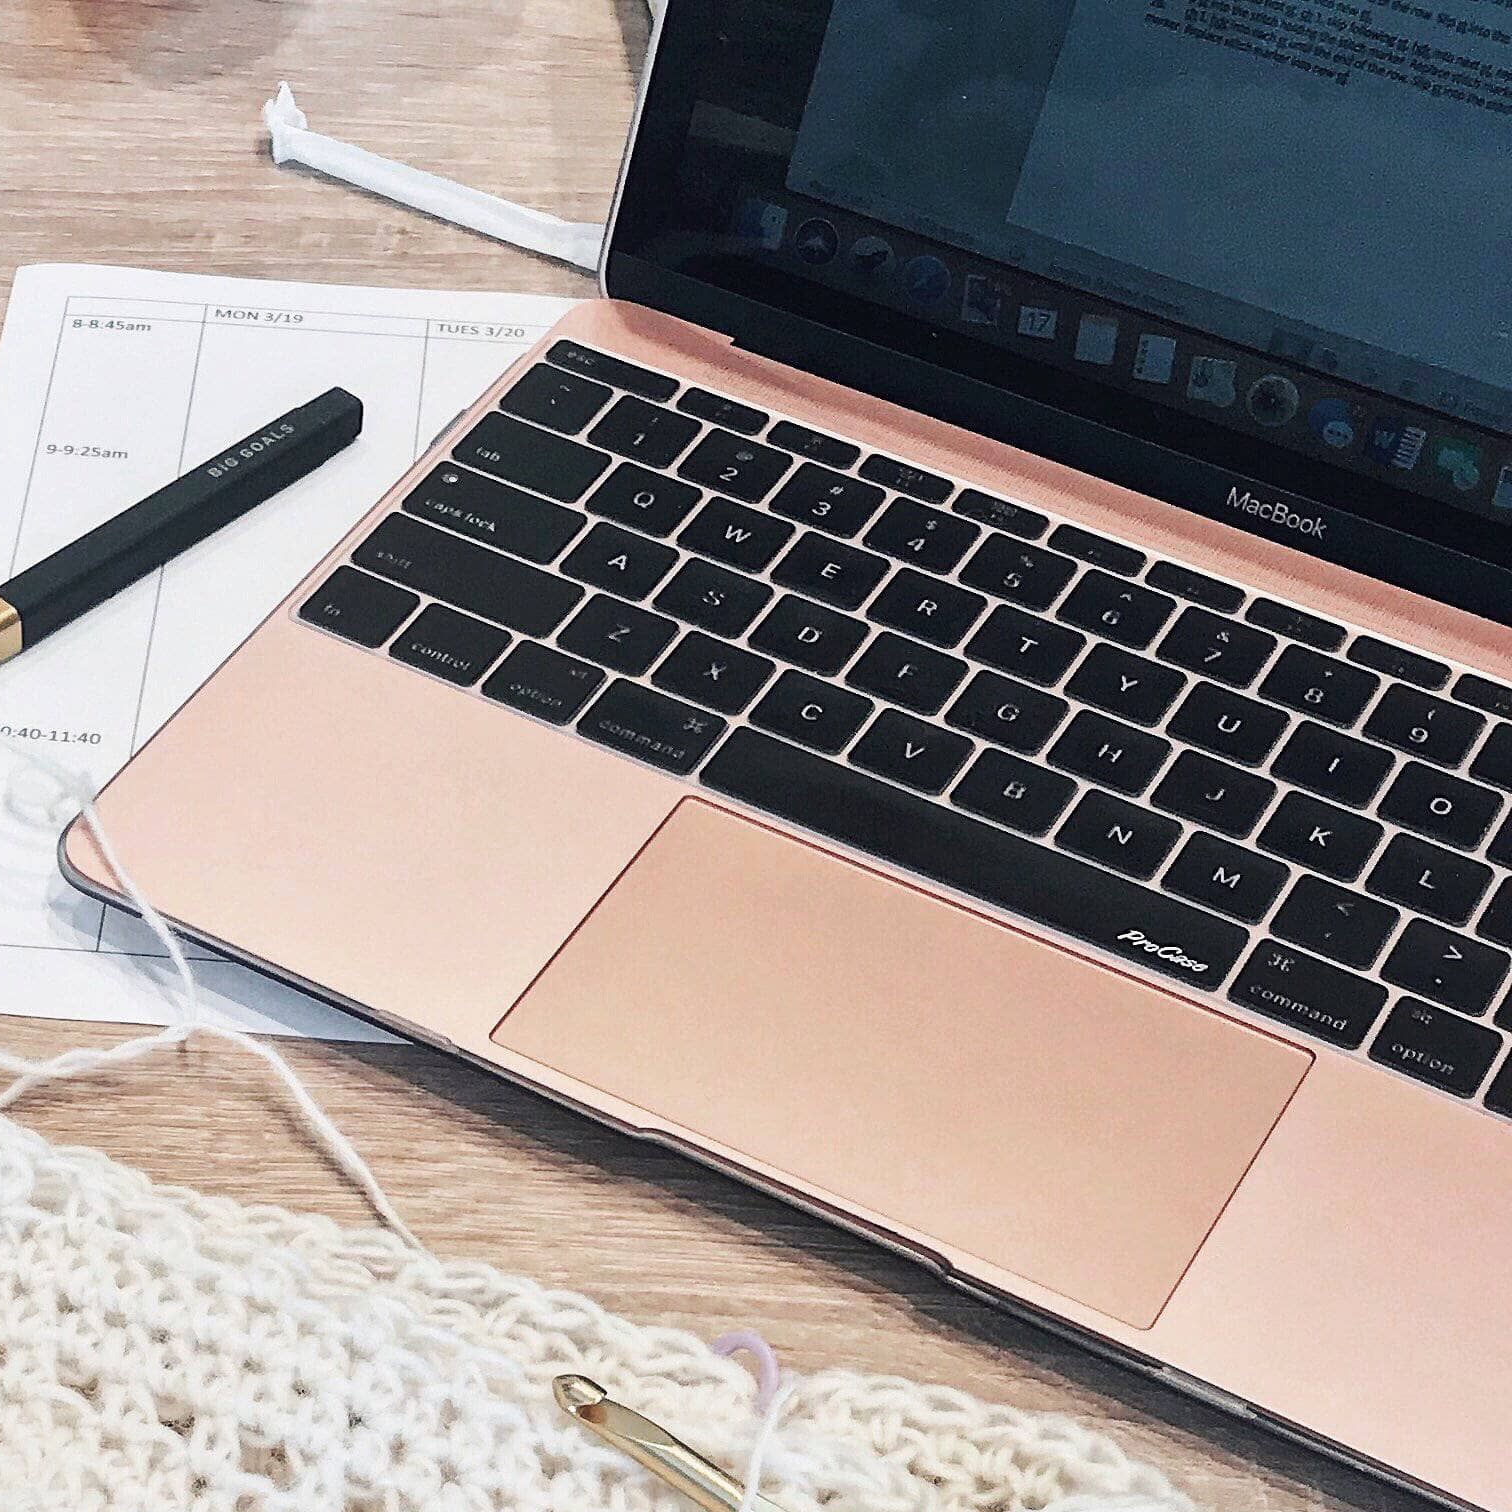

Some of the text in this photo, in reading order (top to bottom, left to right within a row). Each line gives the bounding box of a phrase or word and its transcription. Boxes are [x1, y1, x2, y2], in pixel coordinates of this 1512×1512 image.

[215, 308, 304, 324] MON 3/19
[1027, 312, 1051, 333] 17
[72, 318, 152, 332] 8-8:45am
[437, 323, 525, 338] TUES 3/20
[46, 444, 129, 460] 9-9:25am
[207, 423, 296, 479] BIG GOALS
[475, 446, 501, 463] tab
[719, 467, 738, 482] 2
[633, 491, 655, 509] Q
[811, 501, 832, 516] 3
[1226, 486, 1327, 540] MacBook
[724, 525, 752, 543] W
[607, 554, 627, 571] A
[820, 562, 842, 579] E
[702, 590, 725, 606] S
[916, 599, 938, 616] R
[608, 627, 631, 641] Z
[797, 626, 820, 643] D
[1019, 636, 1039, 653] T
[410, 642, 471, 672] control
[703, 663, 723, 681] X
[1120, 675, 1138, 692] Y
[1303, 687, 1324, 704] 8
[801, 703, 823, 720] C
[997, 703, 1020, 722] G
[1217, 714, 1242, 733] U
[598, 719, 686, 759] command
[1409, 727, 1429, 743] 9
[905, 742, 925, 759] V
[1098, 744, 1123, 763] H
[1003, 782, 1027, 799] B
[1205, 788, 1225, 801] J
[1107, 825, 1133, 845] N
[1308, 826, 1331, 847] K
[1212, 866, 1241, 889] M
[1418, 869, 1435, 889] L
[1116, 929, 1209, 972] ProCase
[1249, 983, 1348, 1032] command
[1390, 1041, 1456, 1076] option
